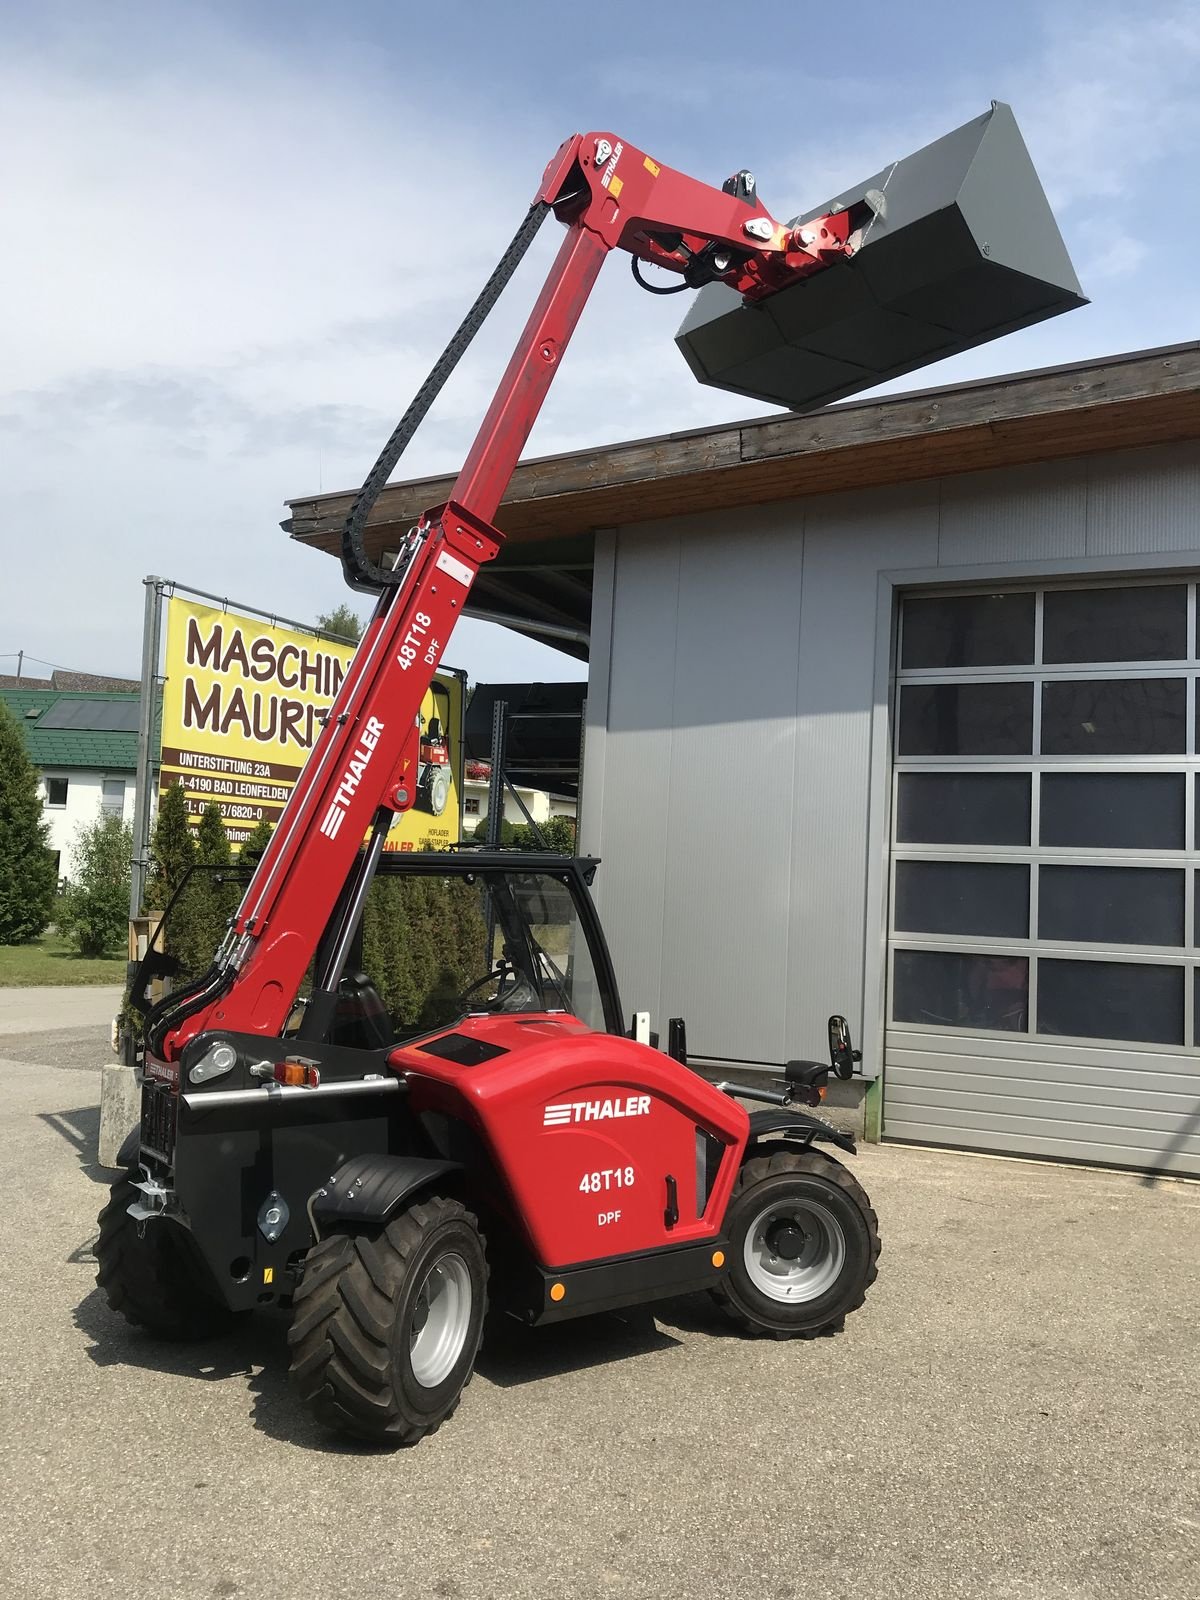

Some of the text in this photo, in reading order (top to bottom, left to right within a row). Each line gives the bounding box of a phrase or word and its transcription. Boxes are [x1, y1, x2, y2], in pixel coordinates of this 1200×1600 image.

[396, 611, 432, 671] 48T18
[424, 638, 440, 666] DPF
[179, 752, 271, 777] UNTERSTIFTUNG 23A
[178, 776, 289, 801] A-4190 BAD LEONFELDEN
[199, 802, 263, 820] 03/6820-0
[578, 1166, 635, 1194] 48T18
[597, 1209, 622, 1227] DPF
